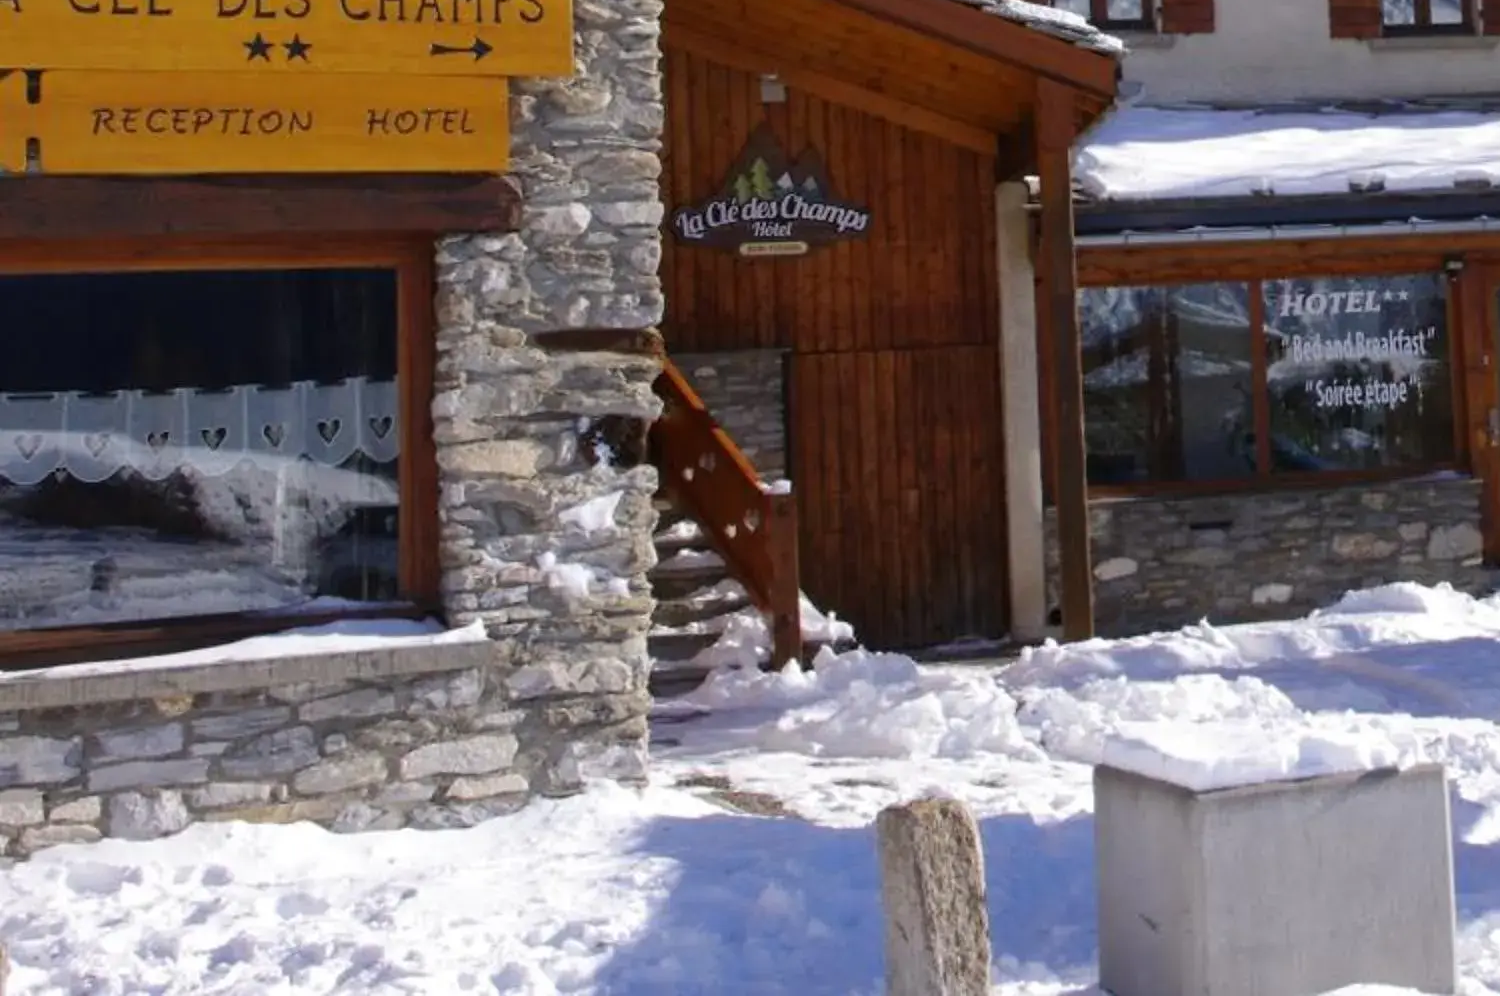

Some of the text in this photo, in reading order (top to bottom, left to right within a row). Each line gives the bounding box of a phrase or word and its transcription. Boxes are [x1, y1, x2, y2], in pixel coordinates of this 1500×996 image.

[92, 107, 476, 136] RECEPTION HOTEL
[676, 193, 870, 239] La Clé des Champs
